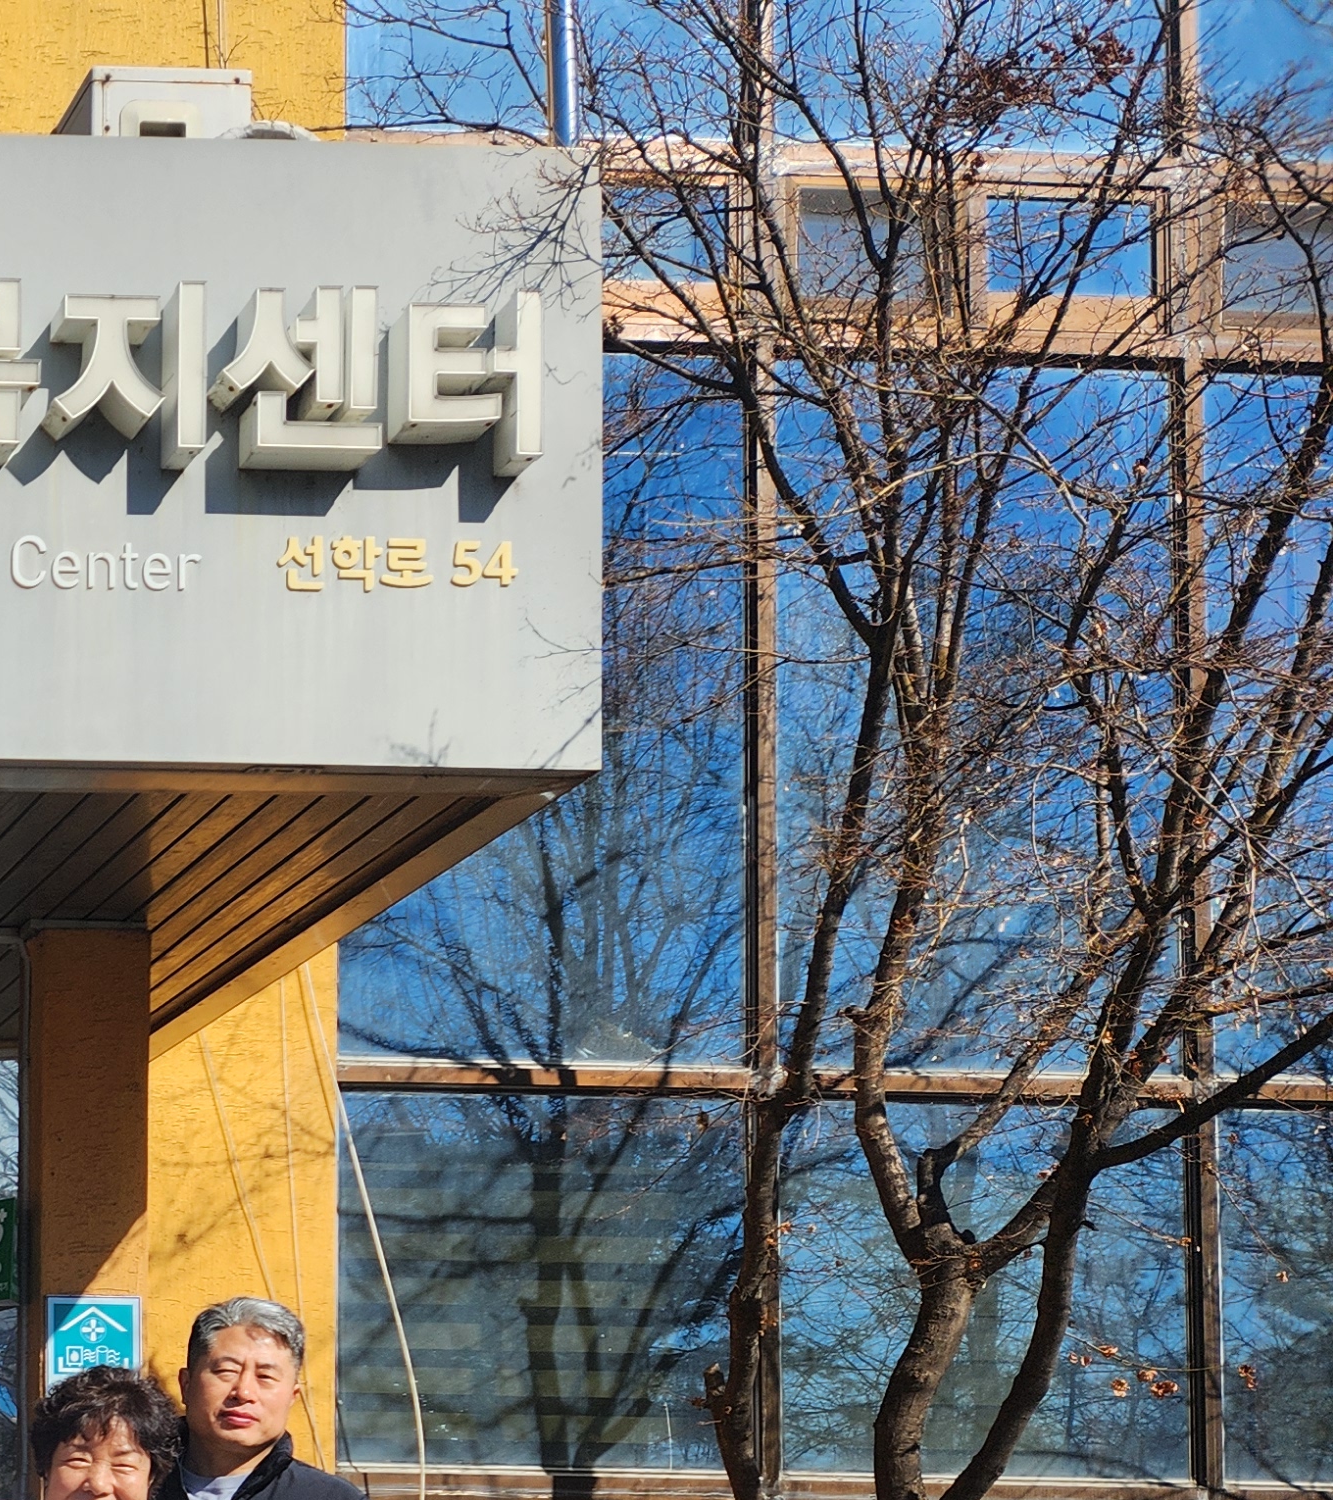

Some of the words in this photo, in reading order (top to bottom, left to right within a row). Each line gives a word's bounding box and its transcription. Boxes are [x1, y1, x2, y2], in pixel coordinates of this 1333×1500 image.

[9, 536, 202, 593] Center
[276, 537, 432, 593] 선학로
[450, 541, 519, 589] 54
